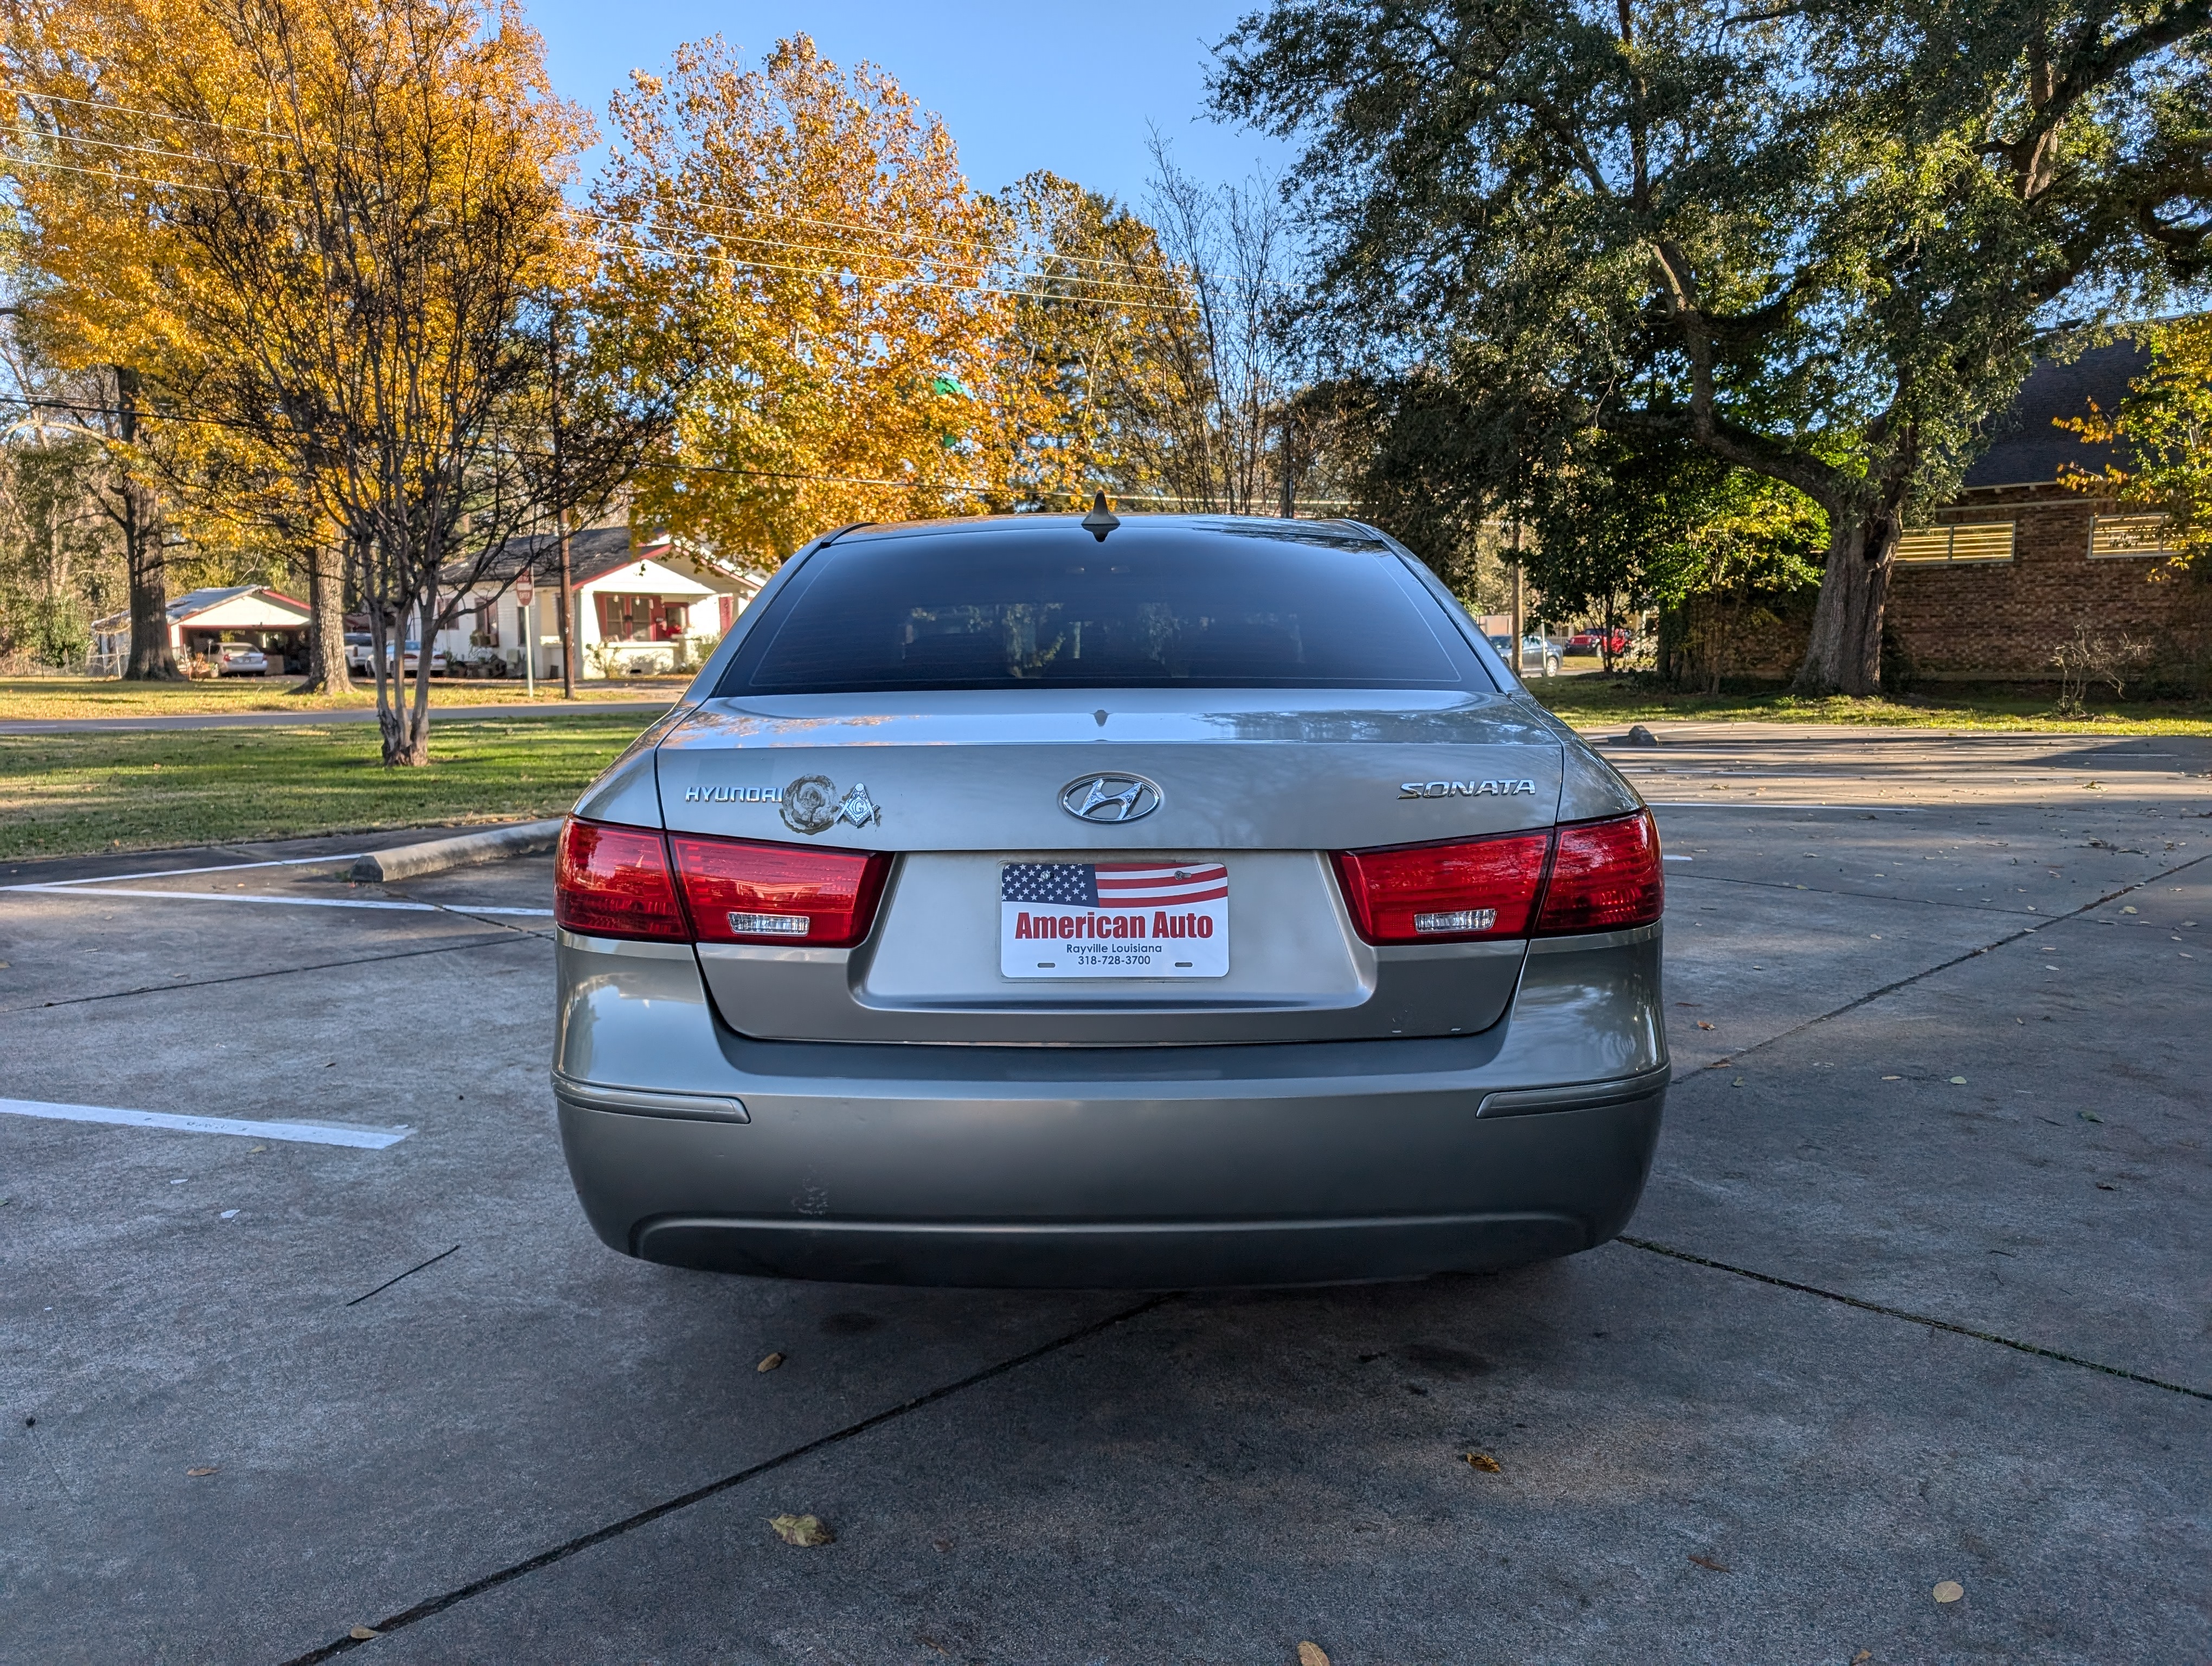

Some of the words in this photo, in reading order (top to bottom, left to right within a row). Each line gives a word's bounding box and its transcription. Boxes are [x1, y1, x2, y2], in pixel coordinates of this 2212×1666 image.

[685, 786, 785, 803] HYUNDAI
[1397, 779, 1535, 799] SONATA
[1015, 911, 1146, 939] American
[1152, 911, 1213, 939] Auto
[1066, 944, 1108, 954] Rayville
[1111, 944, 1162, 953] Louisiana
[1078, 956, 1150, 965] 318-728-3700
